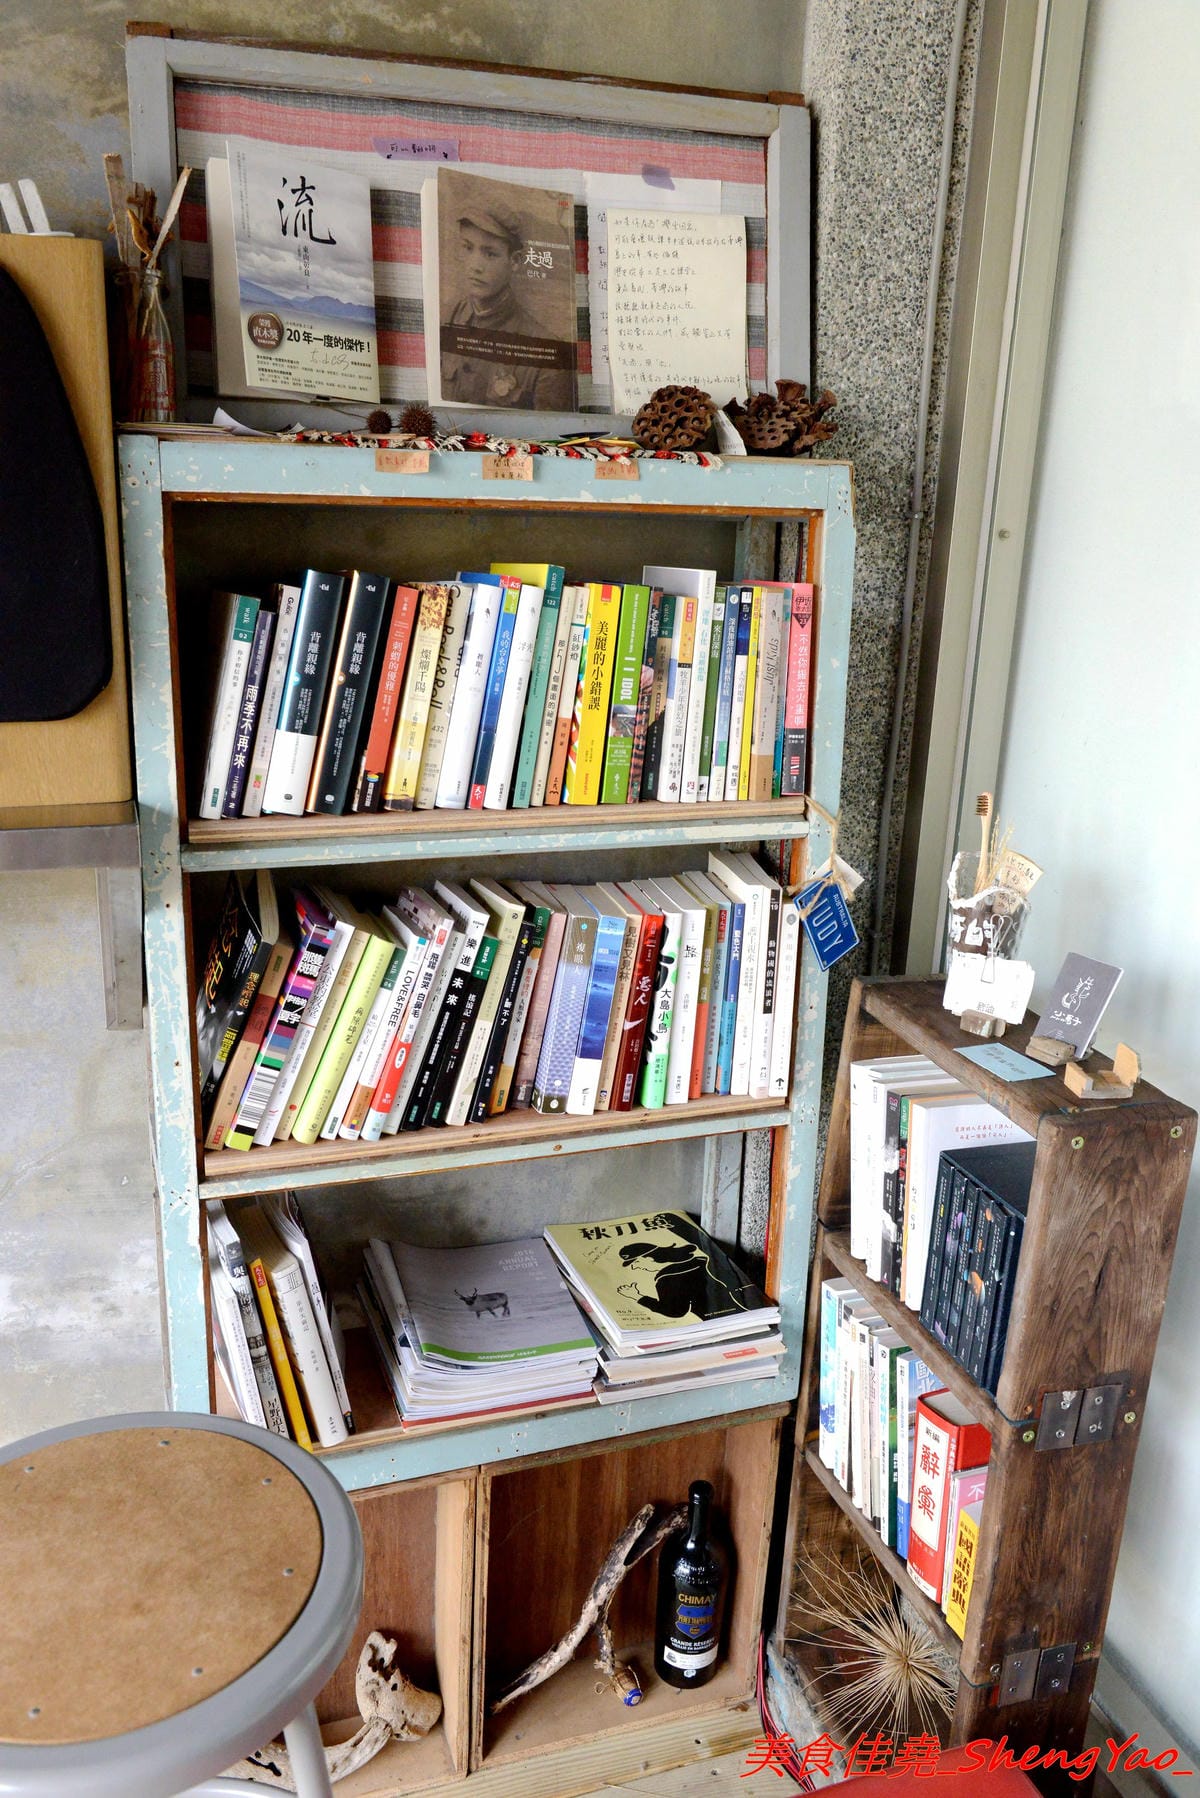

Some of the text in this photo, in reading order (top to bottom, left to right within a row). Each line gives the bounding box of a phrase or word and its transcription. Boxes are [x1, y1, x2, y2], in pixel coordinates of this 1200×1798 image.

[277, 175, 337, 245] 流
[523, 247, 554, 269] 走過
[303, 631, 322, 676] 背離親緣
[348, 631, 367, 676] 背離親緣
[384, 641, 403, 691] 刺蝟的優雅
[415, 648, 431, 694] 燦爛千陽
[588, 620, 609, 711] 美麗的小錯誤
[233, 684, 259, 768] 雨季不再來
[481, 946, 490, 964] mark
[574, 942, 585, 975] 複眼人
[618, 926, 637, 982] 見樹又見林
[387, 969, 415, 1028] LOVE&FREE
[656, 988, 671, 1034] 大島小島
[578, 1216, 675, 1241] 秋刀魚
[952, 1530, 974, 1614] 國語辭典
[678, 1593, 717, 1605] CHIMAY
